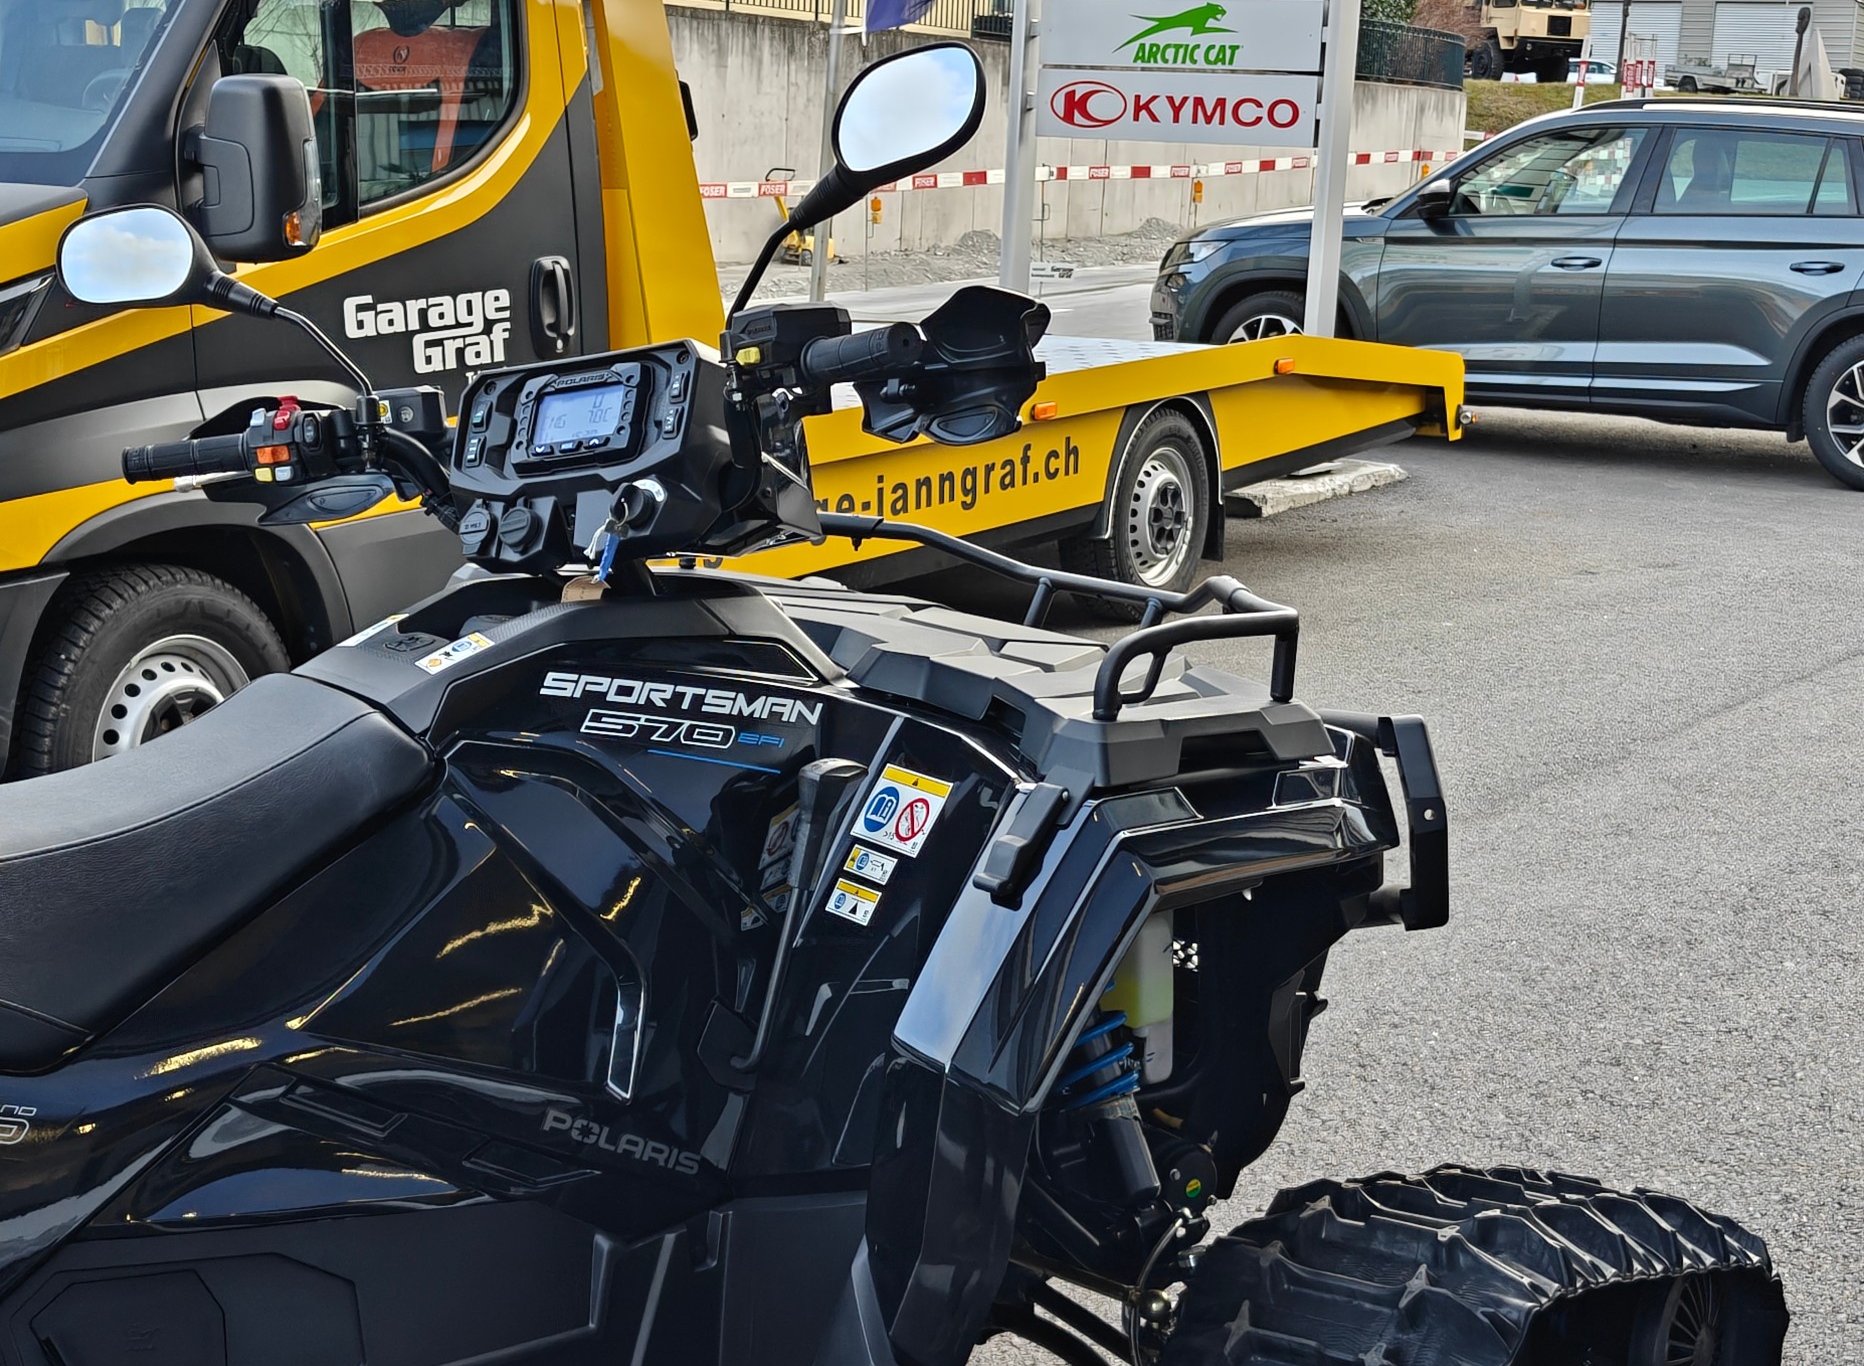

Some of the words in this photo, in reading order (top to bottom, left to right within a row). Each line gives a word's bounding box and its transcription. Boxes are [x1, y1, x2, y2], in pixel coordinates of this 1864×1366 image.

[1132, 42, 1201, 65] ARCTIC
[1203, 43, 1240, 66] CAT
[1132, 93, 1300, 129] KYMCO
[760, 183, 786, 195] FOSER
[343, 288, 511, 339] Garage
[412, 321, 512, 374] Graf
[556, 374, 606, 387] POLARIS
[539, 671, 824, 726] SPORTSMAN
[579, 708, 736, 749] 570
[737, 732, 785, 748] EFI
[542, 1108, 701, 1176] POLARIS
